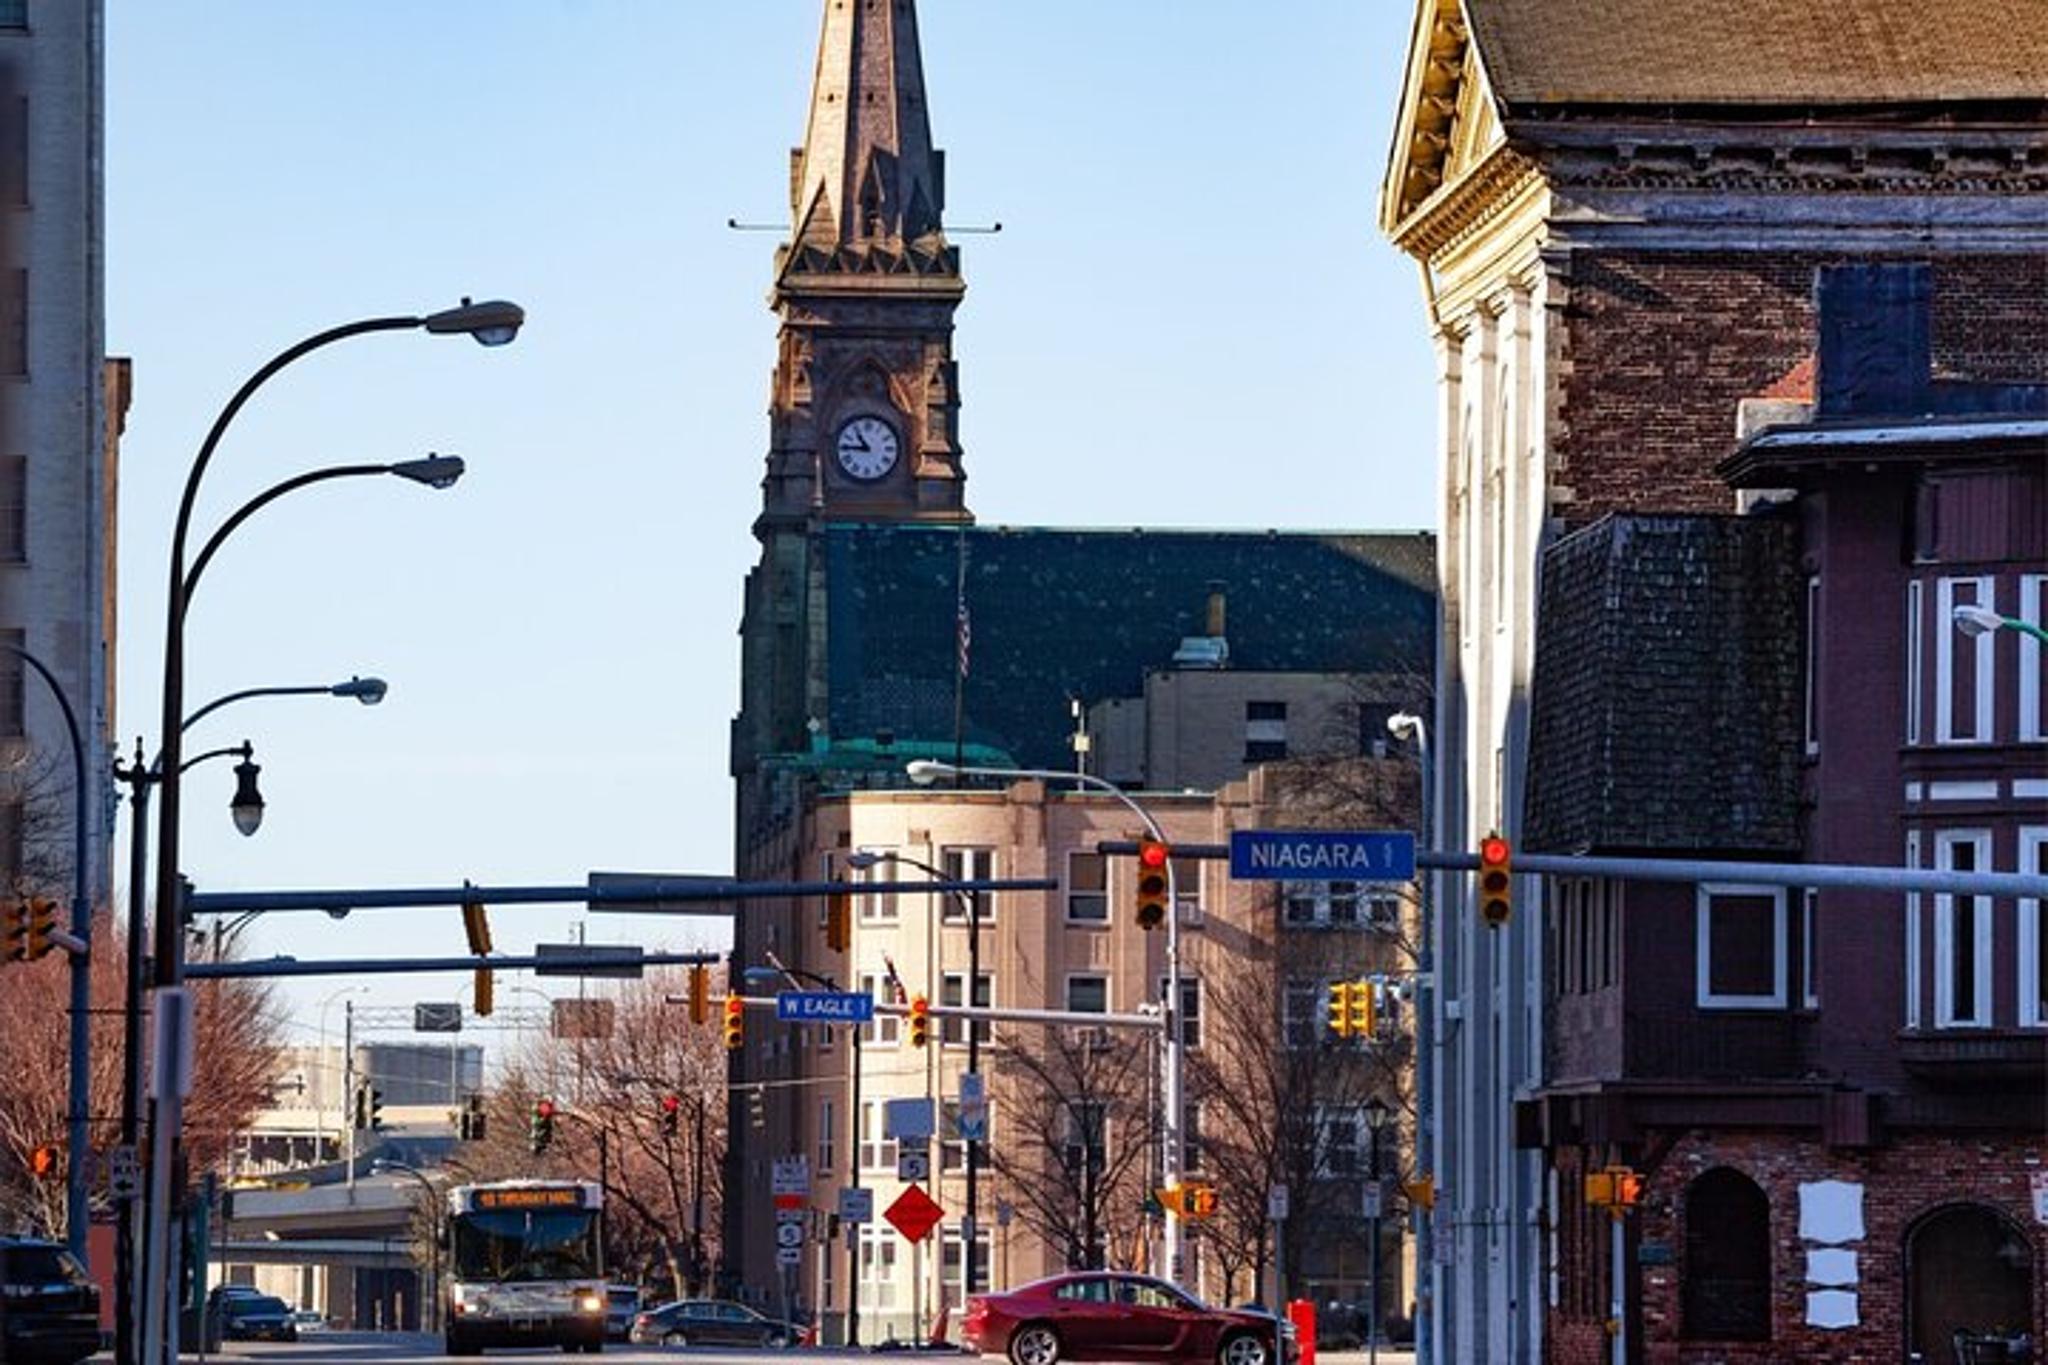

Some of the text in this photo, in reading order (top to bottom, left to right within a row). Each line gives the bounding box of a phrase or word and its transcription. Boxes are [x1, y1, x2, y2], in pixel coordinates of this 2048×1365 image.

[1250, 842, 1370, 868] NIAGARA
[785, 996, 798, 1014] W
[804, 997, 854, 1016] EAGLE
